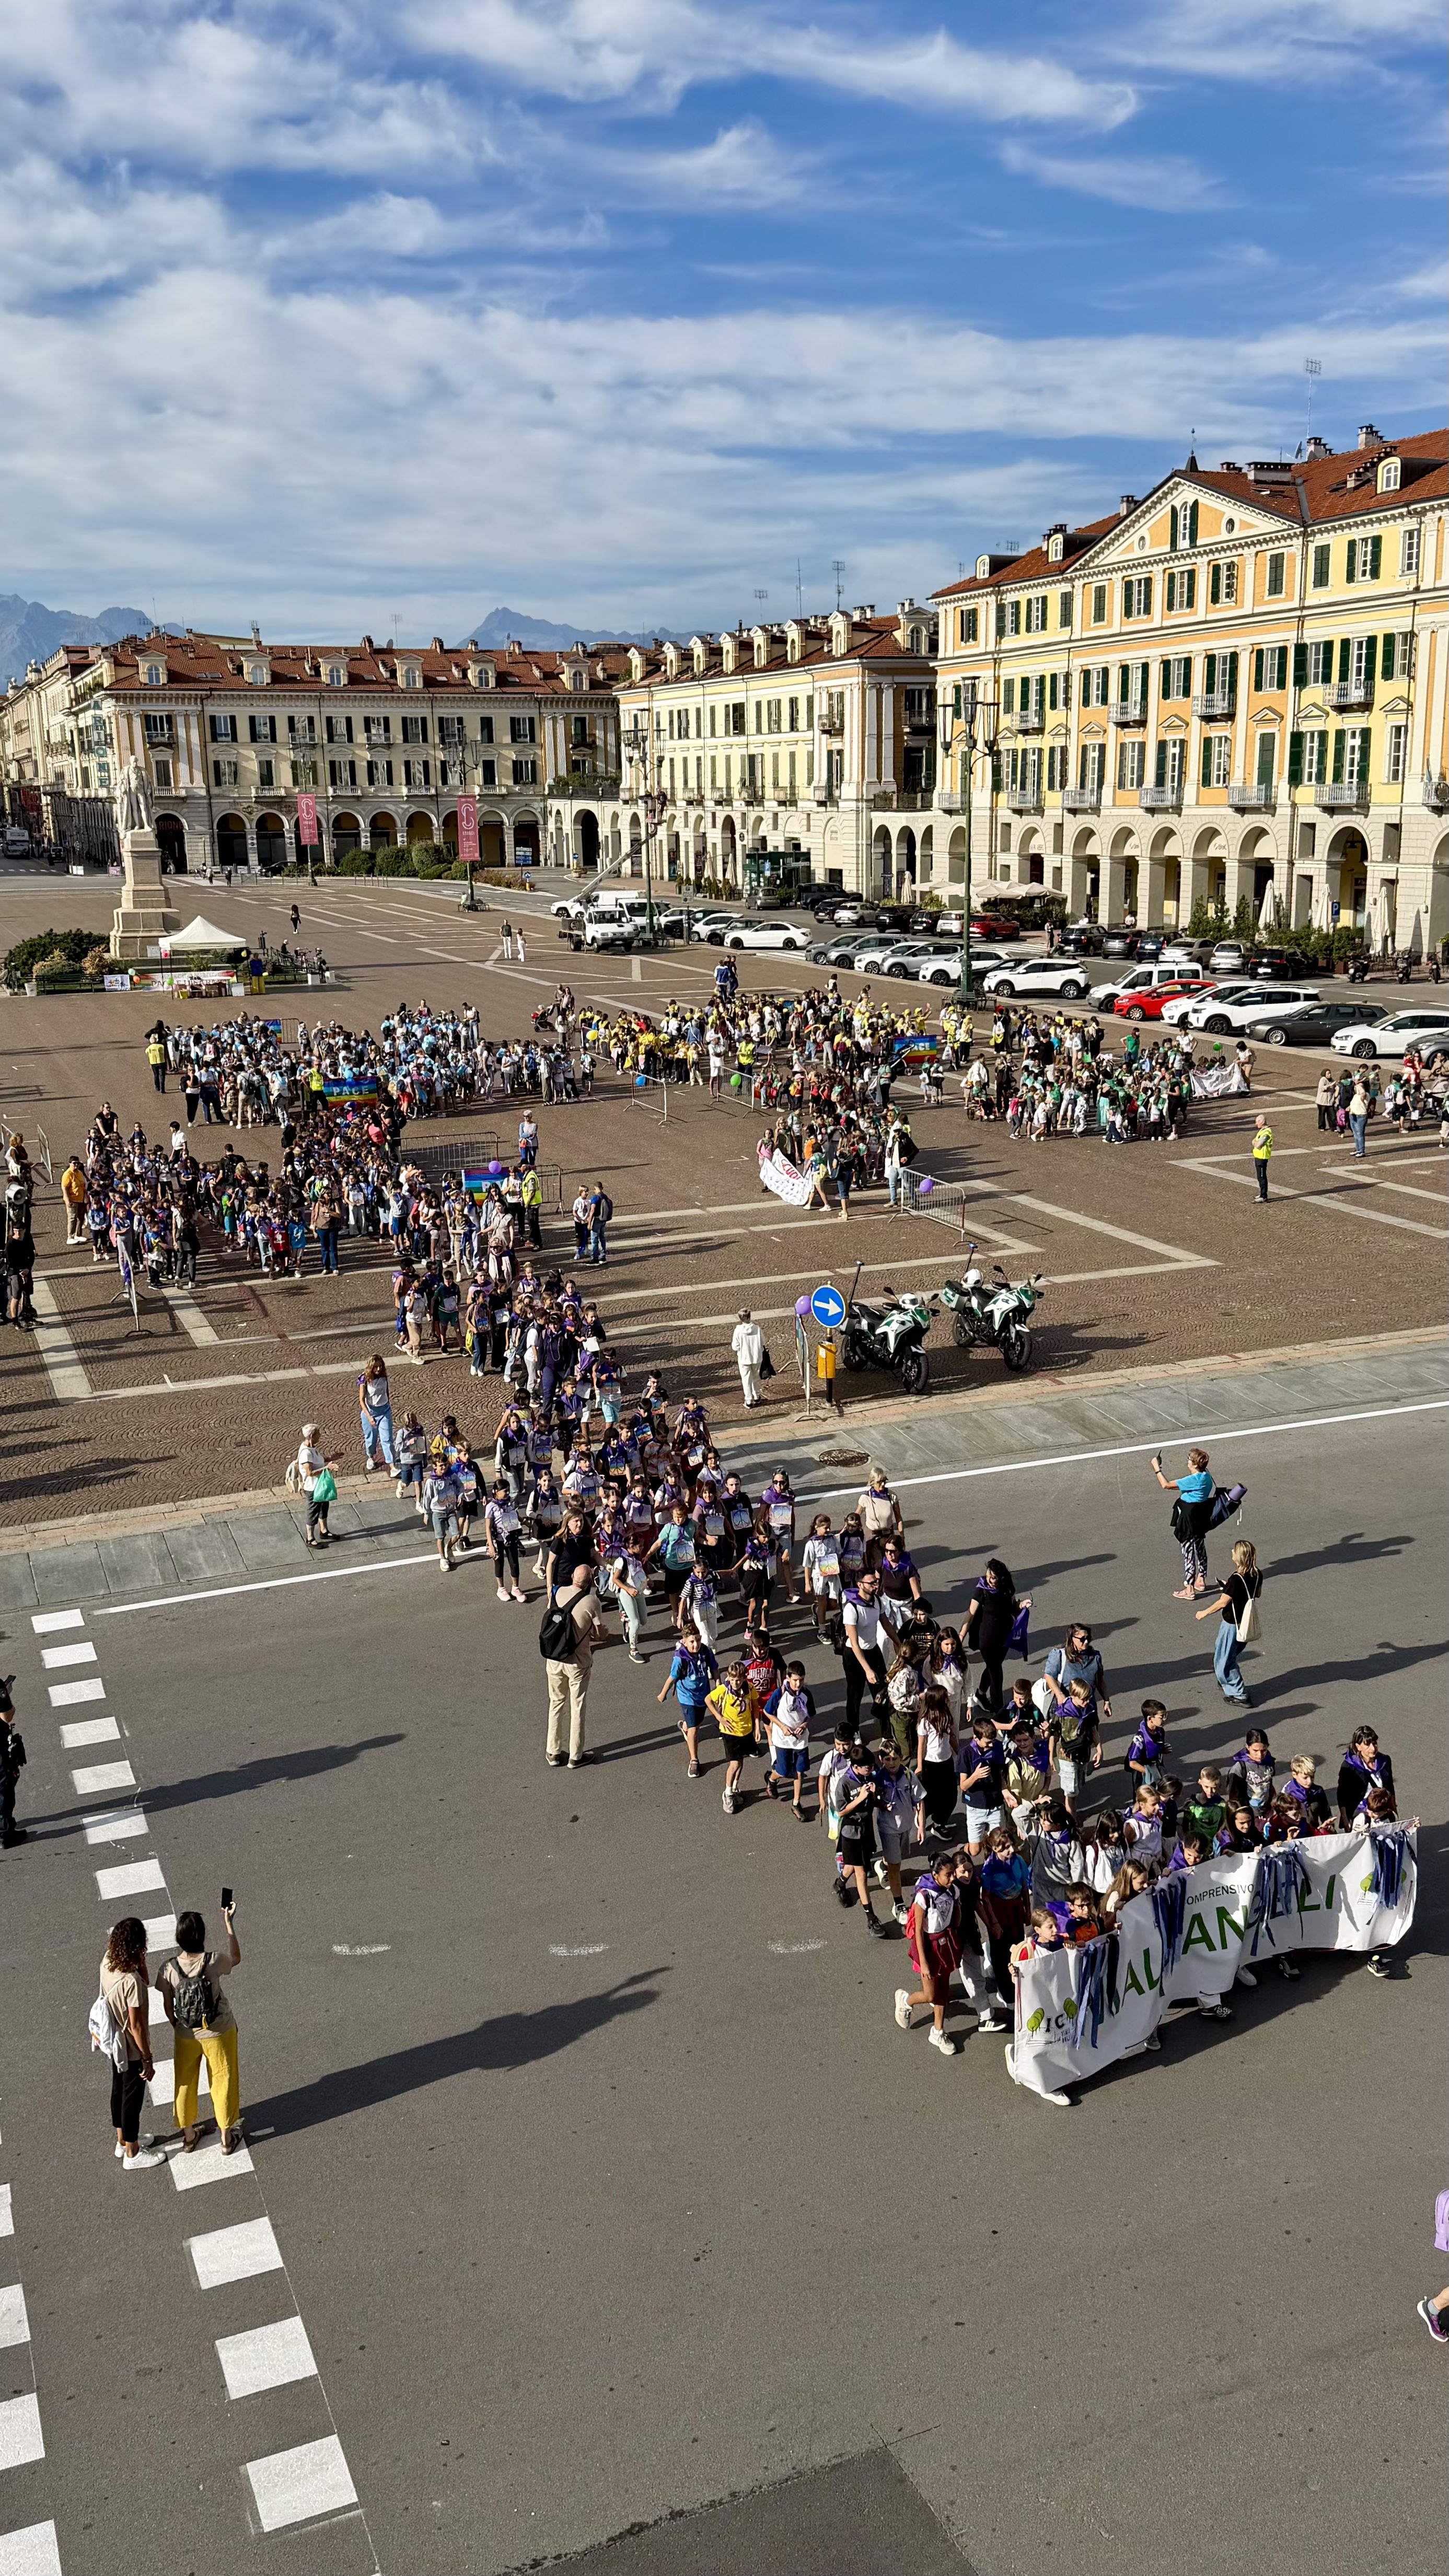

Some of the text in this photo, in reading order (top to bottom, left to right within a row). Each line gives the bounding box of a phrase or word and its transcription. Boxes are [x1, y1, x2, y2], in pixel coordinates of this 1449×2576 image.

[1333, 903, 1339, 914] P
[333, 1086, 369, 1096] PACE
[752, 1677, 770, 1691] 23
[1186, 1884, 1255, 1906] OMPRENSIVO
